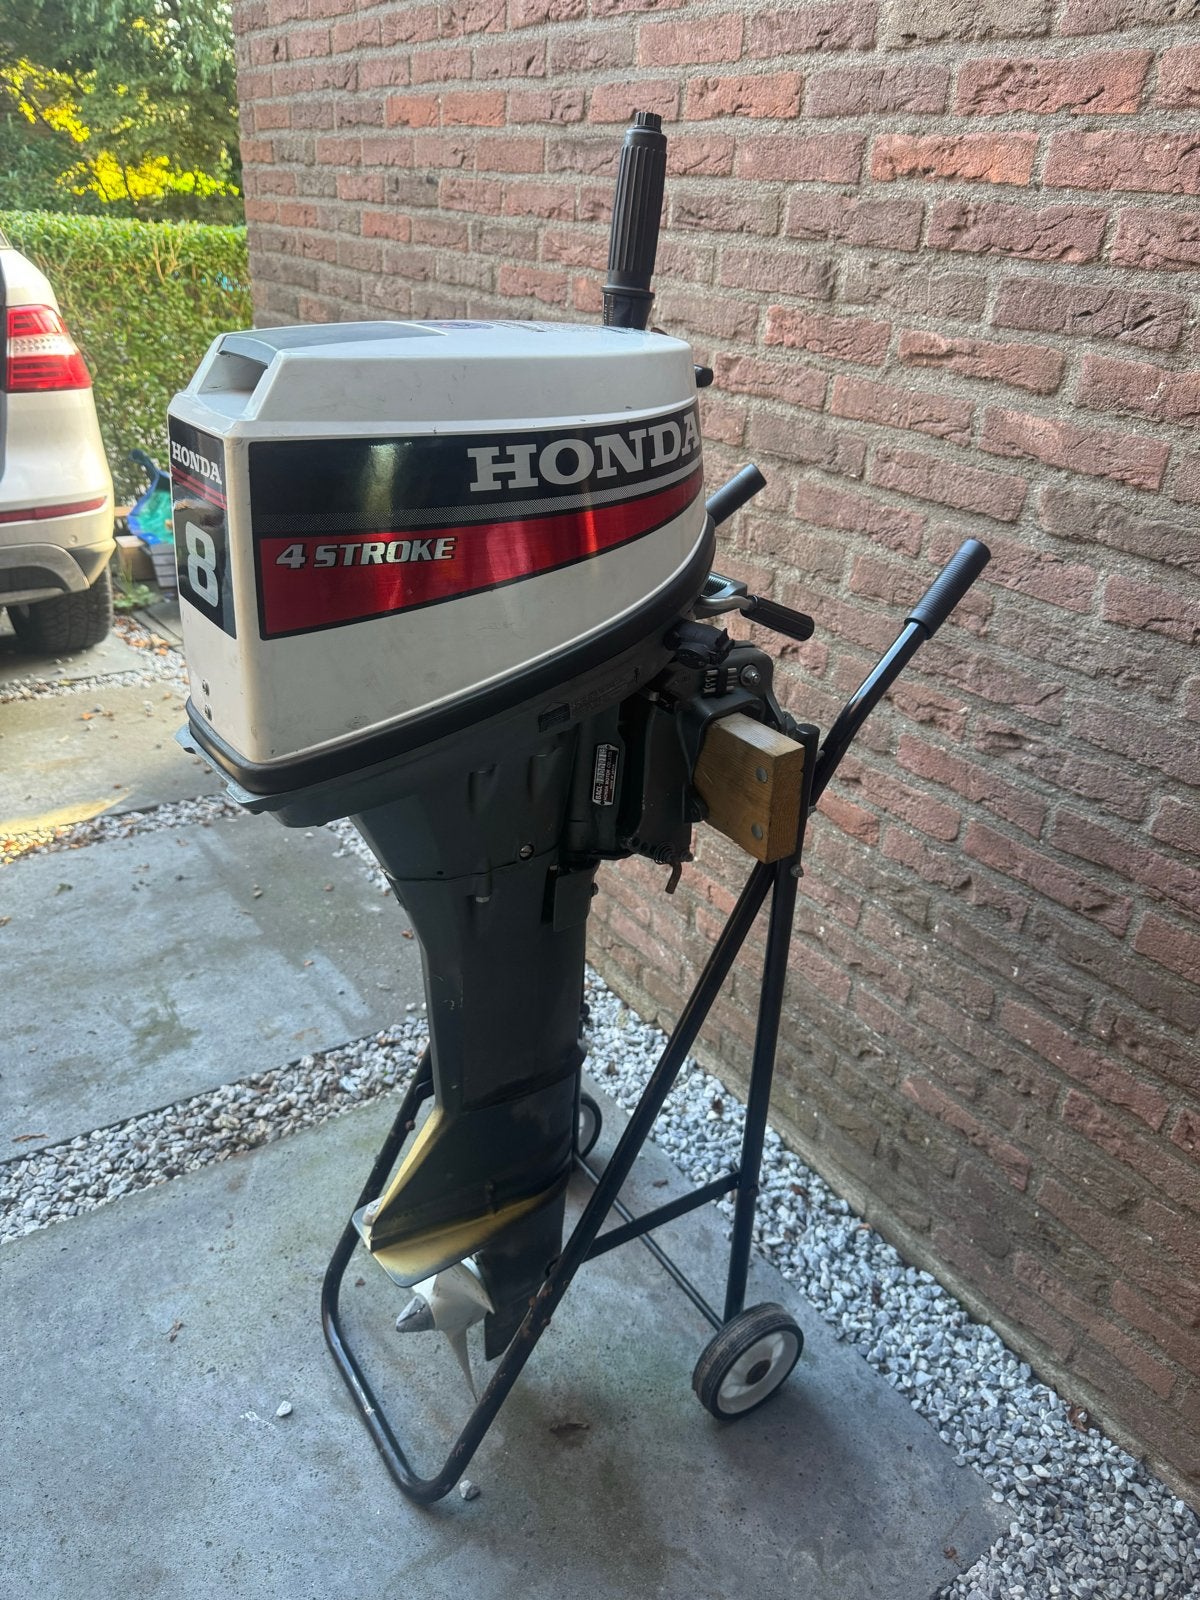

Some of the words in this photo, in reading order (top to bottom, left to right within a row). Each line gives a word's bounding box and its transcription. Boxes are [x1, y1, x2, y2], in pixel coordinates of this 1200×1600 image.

[171, 441, 222, 485] HONDA
[467, 411, 700, 492] HONDA
[185, 521, 218, 608] 8
[276, 544, 306, 569] 4
[314, 537, 455, 568] STROKE
